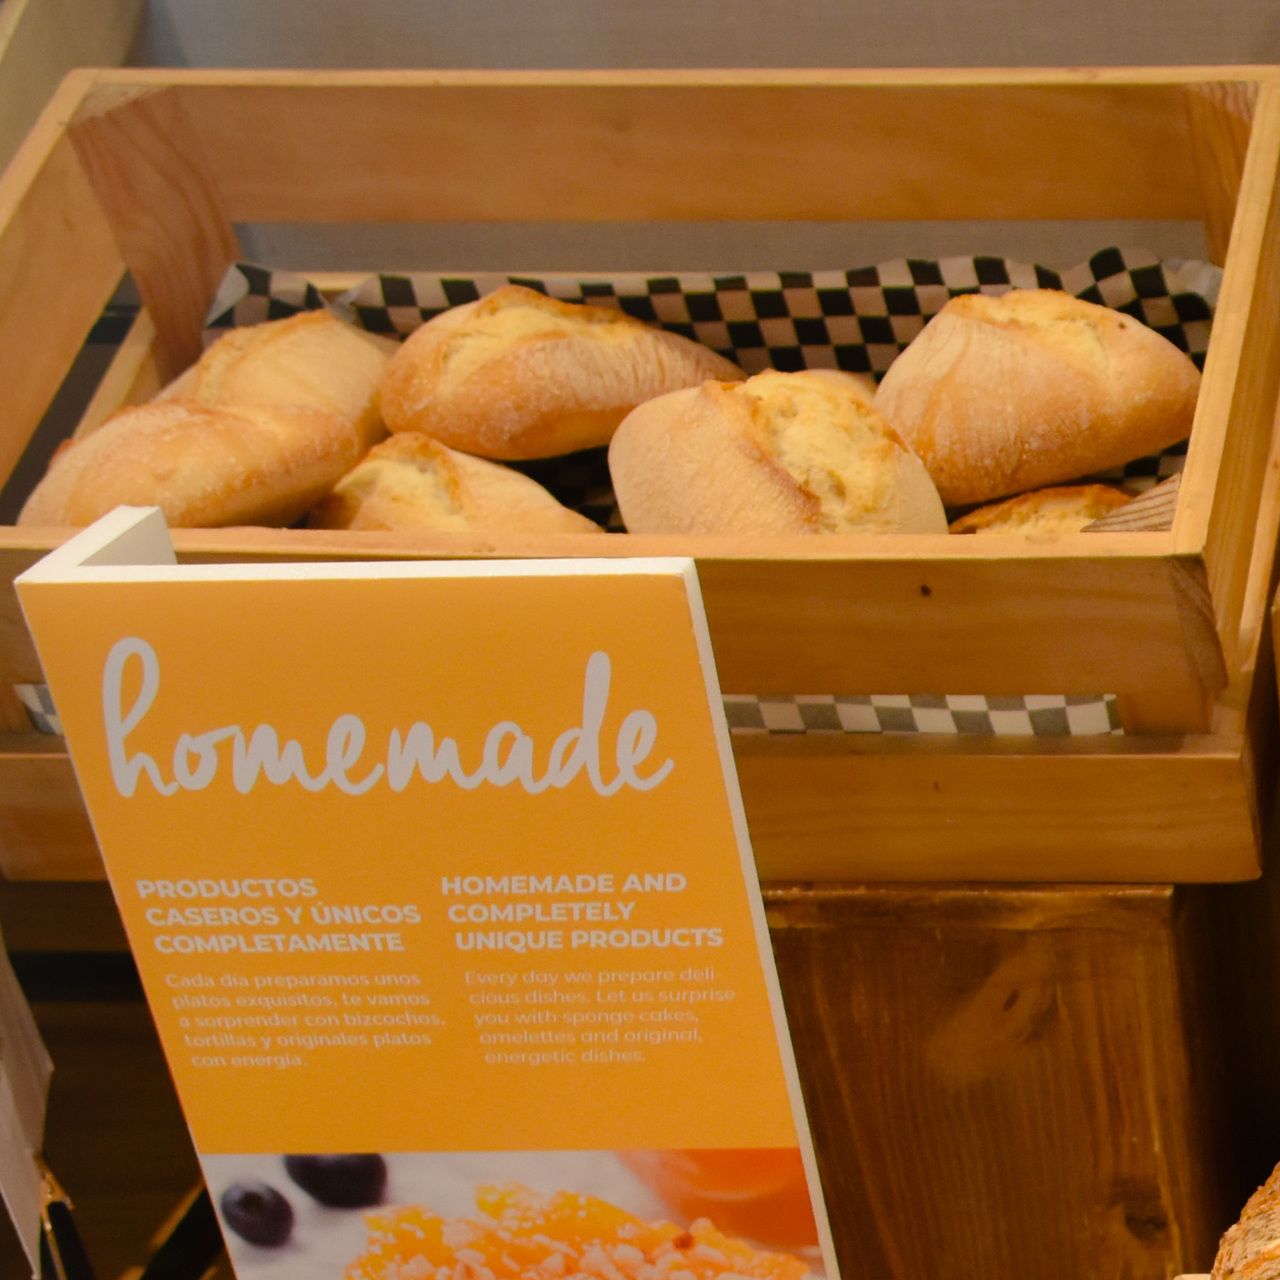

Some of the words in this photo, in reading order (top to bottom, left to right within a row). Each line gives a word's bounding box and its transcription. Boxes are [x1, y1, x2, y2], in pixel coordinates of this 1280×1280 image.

[103, 636, 675, 798] homemade
[135, 878, 318, 899] PRODUCTOS
[441, 874, 614, 896] HOMEMADE
[623, 873, 687, 893] AND
[145, 907, 279, 926] CASEROS
[283, 906, 303, 925] Y
[310, 901, 422, 925] ÚNICOS
[447, 901, 636, 924] COMPLETELY
[154, 932, 405, 953] COMPLETAMENTE
[455, 930, 564, 953] UNIQUE
[571, 927, 724, 949] PRODUCTS
[165, 973, 215, 988] Cada
[254, 974, 370, 991] preparamos
[374, 974, 421, 986] unos
[465, 970, 517, 987] Every
[522, 969, 559, 987] day
[564, 971, 593, 983] we
[597, 969, 674, 986] prepare
[173, 993, 231, 1011] platos
[236, 992, 338, 1010] exquisitos,
[343, 992, 362, 1006] te
[367, 993, 430, 1006] vamos
[469, 991, 519, 1005] cious
[597, 989, 626, 1003] Let
[632, 990, 654, 1002] us
[658, 987, 736, 1005] surprise
[180, 1017, 190, 1028] a
[195, 1013, 298, 1031] sorprender
[304, 1014, 340, 1027] con
[344, 1012, 446, 1028] bizcochos,
[474, 1012, 509, 1027] you
[514, 1009, 557, 1024] with
[563, 1010, 634, 1026] sponge
[639, 1007, 699, 1023] cakes,
[185, 1033, 256, 1049] tortillas
[262, 1037, 271, 1050] y
[277, 1032, 368, 1050] originales
[372, 1031, 431, 1048] platos
[479, 1030, 576, 1045] omelettes
[580, 1028, 619, 1043] and
[624, 1027, 702, 1046] original,
[191, 1054, 227, 1067] con
[485, 1049, 576, 1066] energetic
[581, 1047, 646, 1063] dishes.
